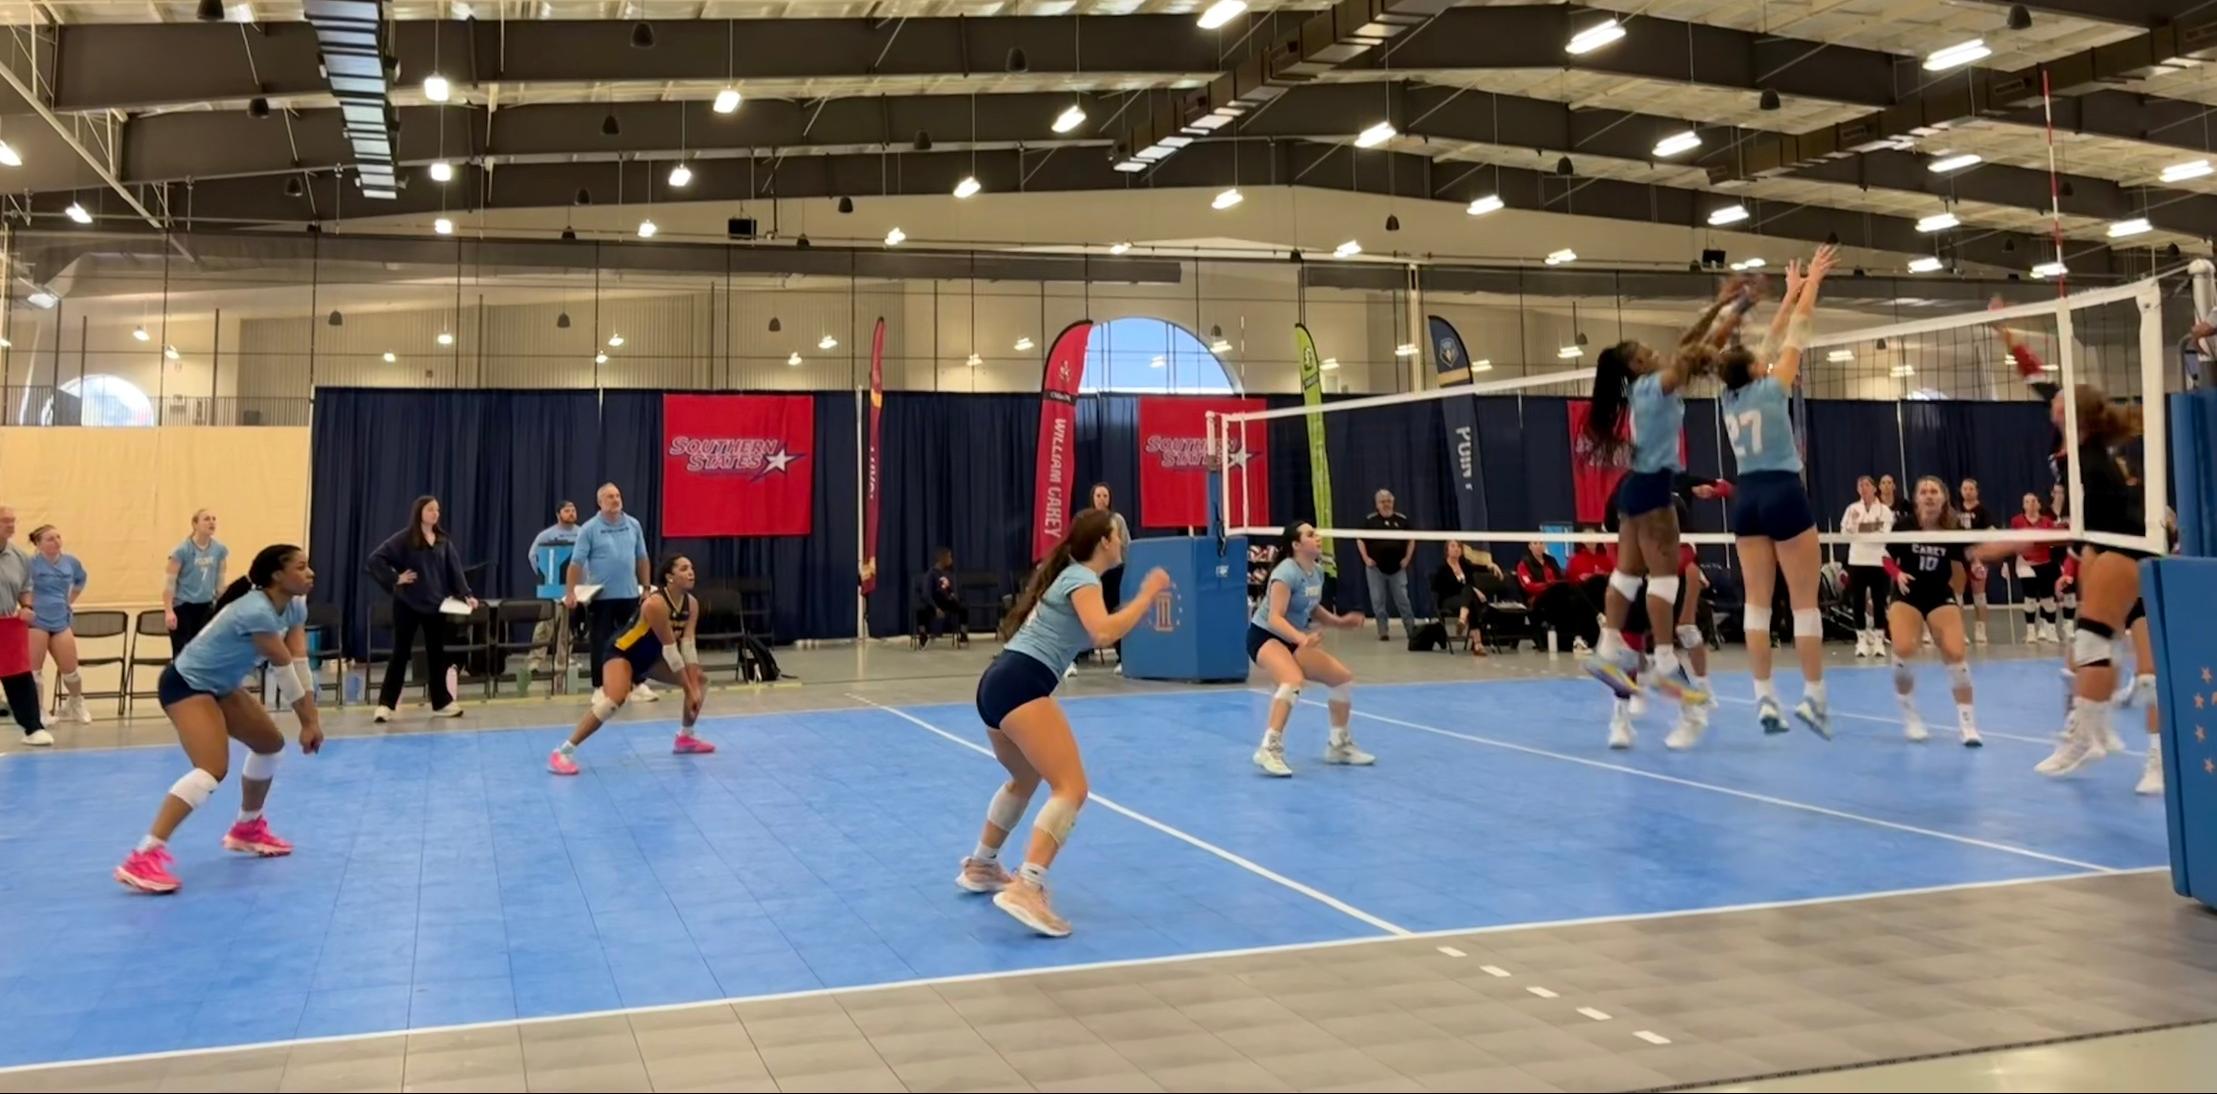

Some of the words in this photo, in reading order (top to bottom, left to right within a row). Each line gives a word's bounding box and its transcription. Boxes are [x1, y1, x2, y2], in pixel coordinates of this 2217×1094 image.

[1724, 410, 1762, 455] 27
[669, 436, 778, 456] SOUTHERN
[1049, 418, 1067, 484] WILLIAM
[687, 453, 763, 471] STATES
[1044, 487, 1063, 538] CAREY
[1911, 543, 1946, 557] CAREY
[1919, 556, 1939, 571] 10
